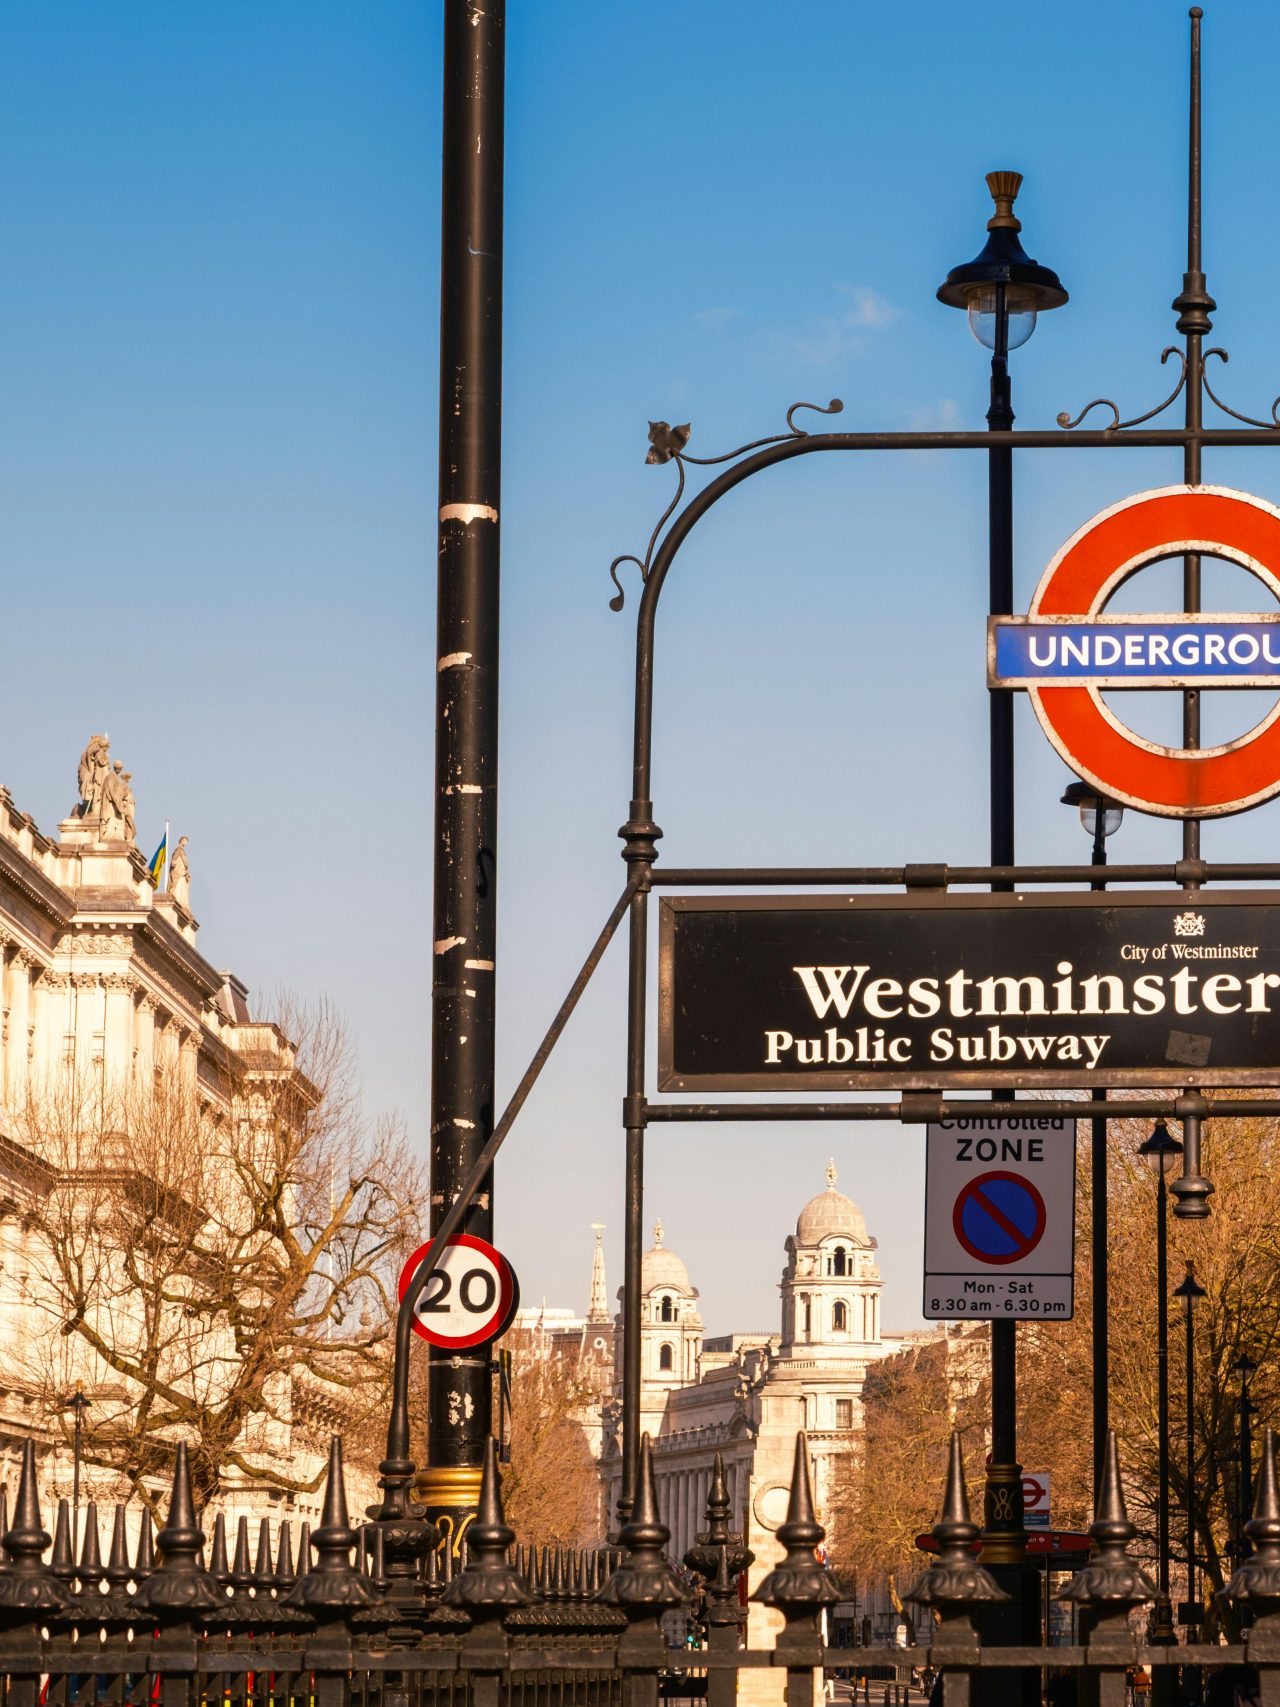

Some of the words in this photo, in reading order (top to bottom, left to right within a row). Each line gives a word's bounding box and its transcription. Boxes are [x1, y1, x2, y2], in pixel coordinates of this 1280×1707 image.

[1120, 944, 1149, 964] City
[1151, 943, 1168, 960] of
[1170, 943, 1259, 960] Westminster
[764, 1027, 912, 1064] Public
[930, 1025, 1111, 1070] Subway
[956, 1138, 1044, 1162] ZONE
[420, 1268, 496, 1314] 20
[963, 1281, 995, 1293] Mon
[1008, 1281, 1034, 1294] Sat
[931, 1299, 966, 1311] 8.30
[970, 1301, 992, 1311] am
[1004, 1299, 1040, 1312] 6.30
[1043, 1302, 1066, 1314] pm
